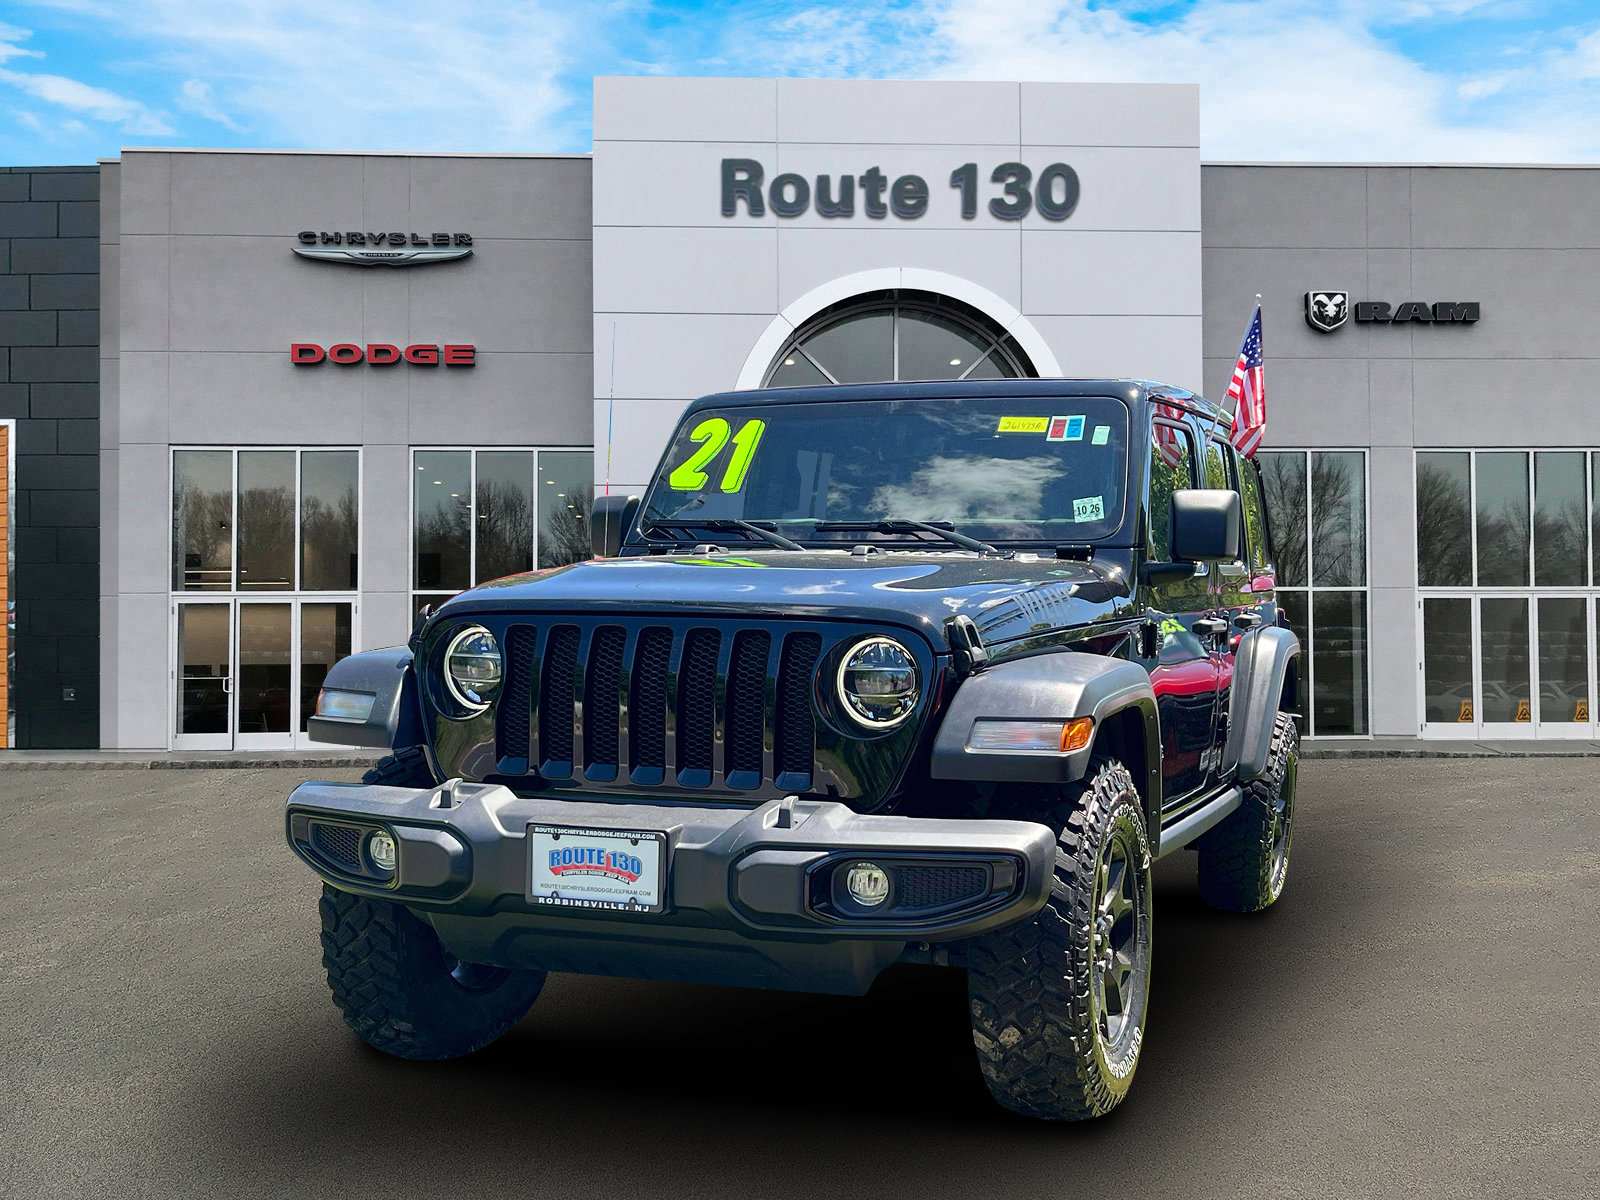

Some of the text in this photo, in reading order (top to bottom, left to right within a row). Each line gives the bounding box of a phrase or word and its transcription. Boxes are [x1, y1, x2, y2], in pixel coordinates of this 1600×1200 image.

[721, 157, 1081, 221] Route 130
[297, 231, 473, 246] CHRYSLER
[1355, 301, 1480, 325] RAM
[290, 343, 475, 366] DODGE
[669, 418, 766, 495] 21
[1077, 503, 1100, 516] 10 26
[535, 827, 656, 839] ROUTE130CHRYSLERDODGEJEEPRAM.COM
[549, 847, 642, 876] ROUTE 130
[540, 883, 652, 896] ROUTE130CHRYSLERDODGEJEEPRAM.COM
[538, 897, 651, 912] ROBBINSVILLE, NJ
